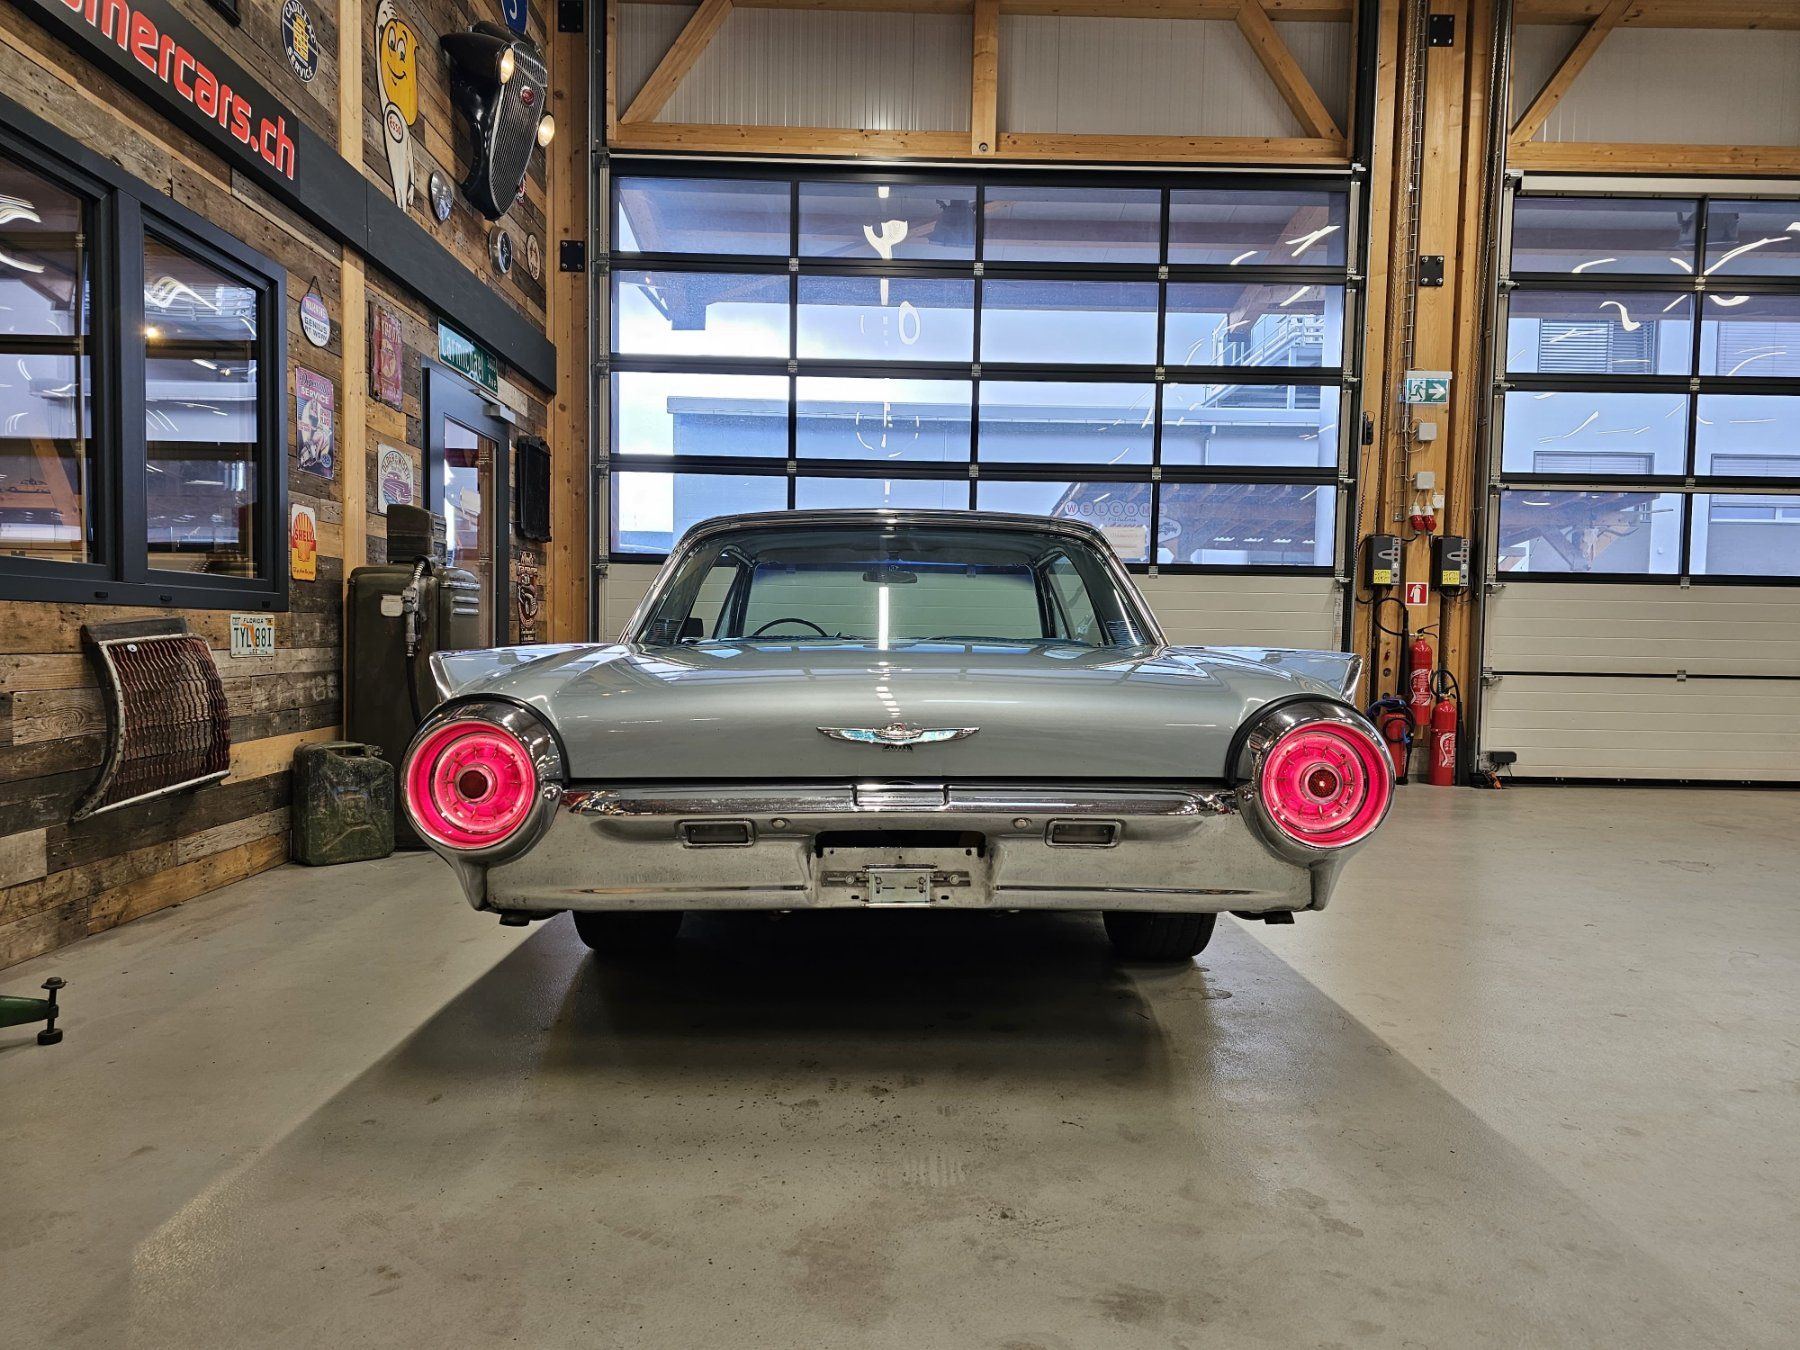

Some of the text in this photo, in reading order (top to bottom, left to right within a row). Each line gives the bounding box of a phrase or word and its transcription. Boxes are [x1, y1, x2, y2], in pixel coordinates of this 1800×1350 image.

[288, 45, 314, 79] SERVICE
[60, 0, 295, 180] mercars.ch
[304, 316, 328, 335] GENIUS
[300, 386, 330, 405] SERVICE
[294, 529, 314, 543] SHELL
